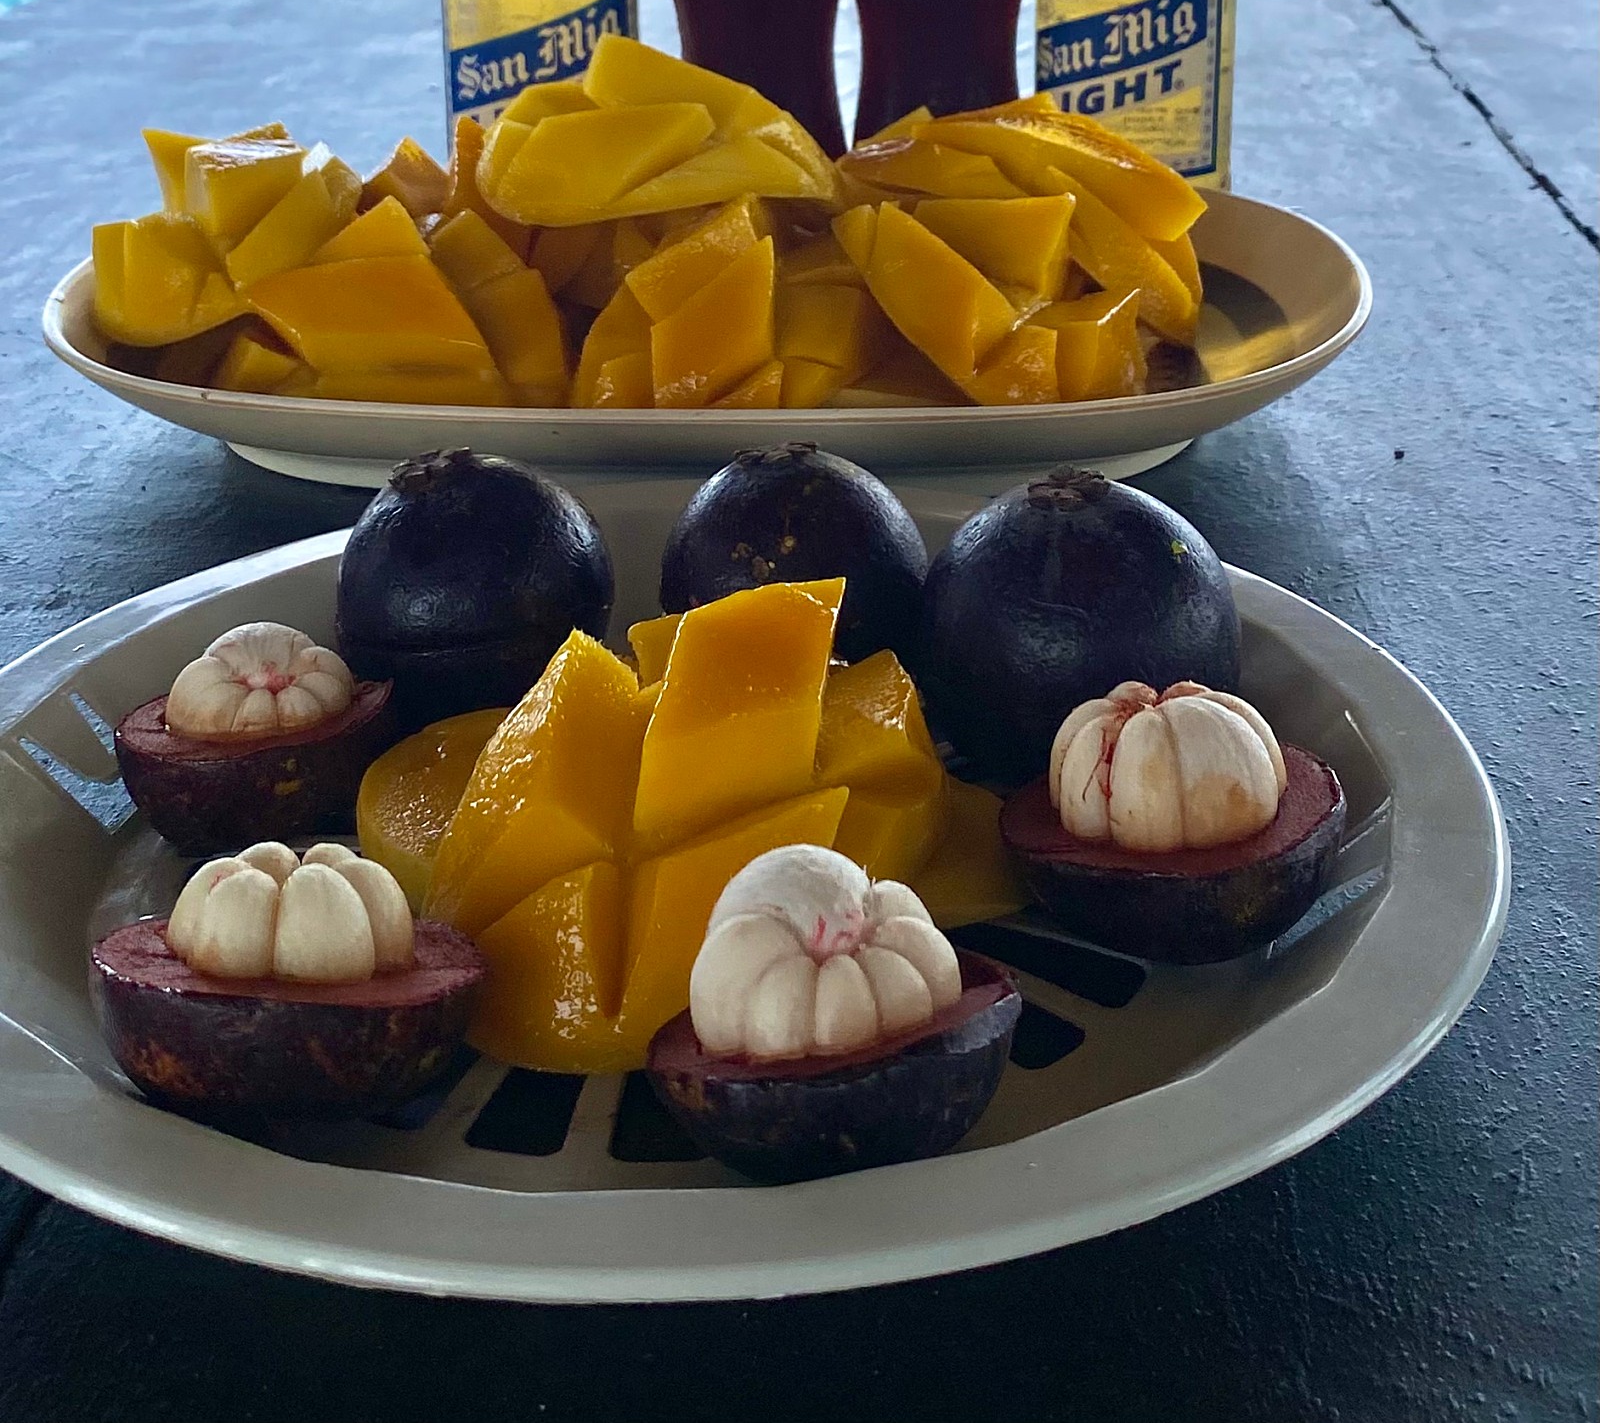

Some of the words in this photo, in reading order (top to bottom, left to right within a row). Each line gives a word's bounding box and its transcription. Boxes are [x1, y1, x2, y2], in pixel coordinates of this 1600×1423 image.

[457, 52, 530, 100] San
[1037, 34, 1095, 79] San
[1060, 59, 1182, 115] IGHT
